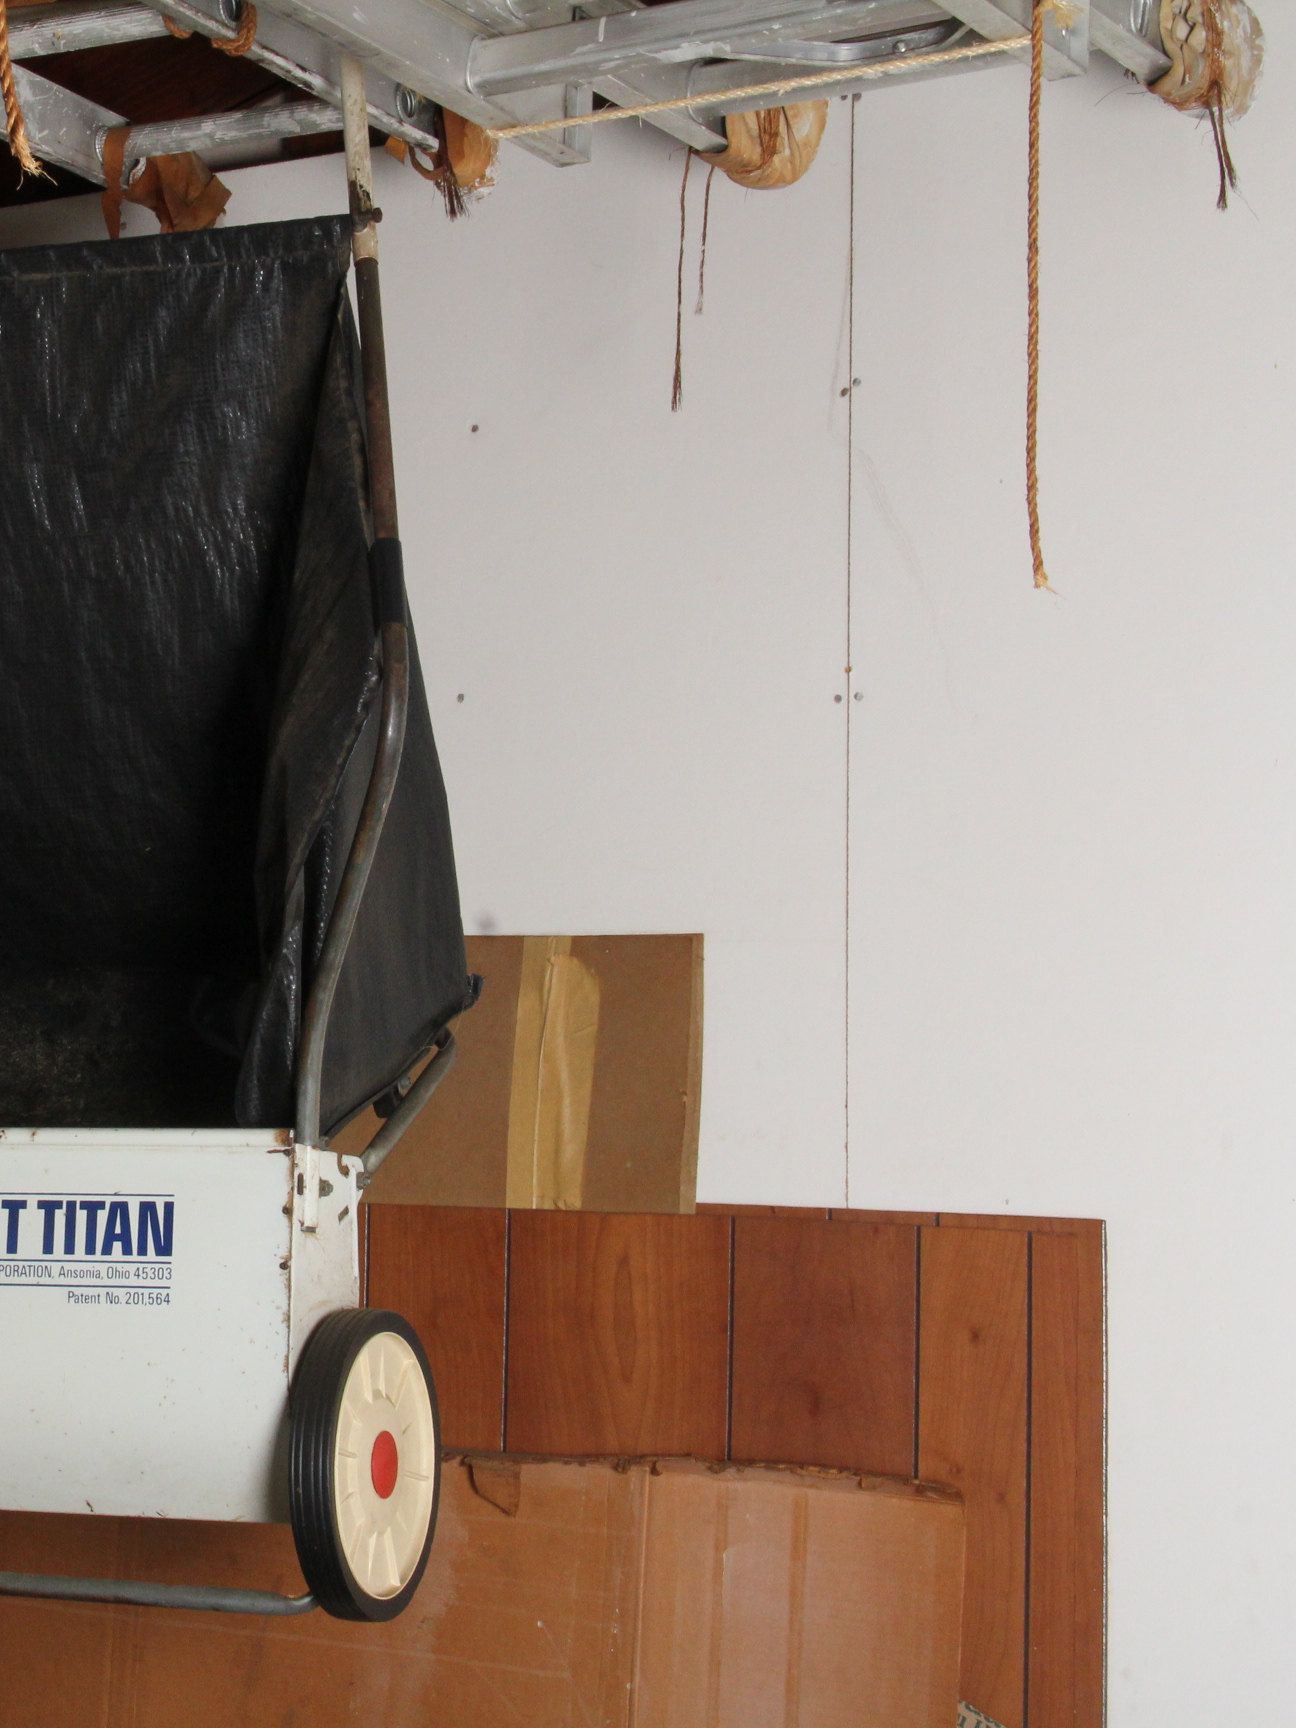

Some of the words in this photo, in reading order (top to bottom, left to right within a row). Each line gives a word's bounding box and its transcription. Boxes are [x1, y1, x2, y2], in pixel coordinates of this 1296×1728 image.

[37, 1199, 175, 1257] TITAN
[58, 1265, 104, 1280] Ansonia,
[106, 1266, 131, 1280] Ohio
[133, 1266, 173, 1281] 45303
[67, 1290, 101, 1305] Patent
[105, 1291, 123, 1305] No.
[125, 1291, 171, 1307] 201,564
